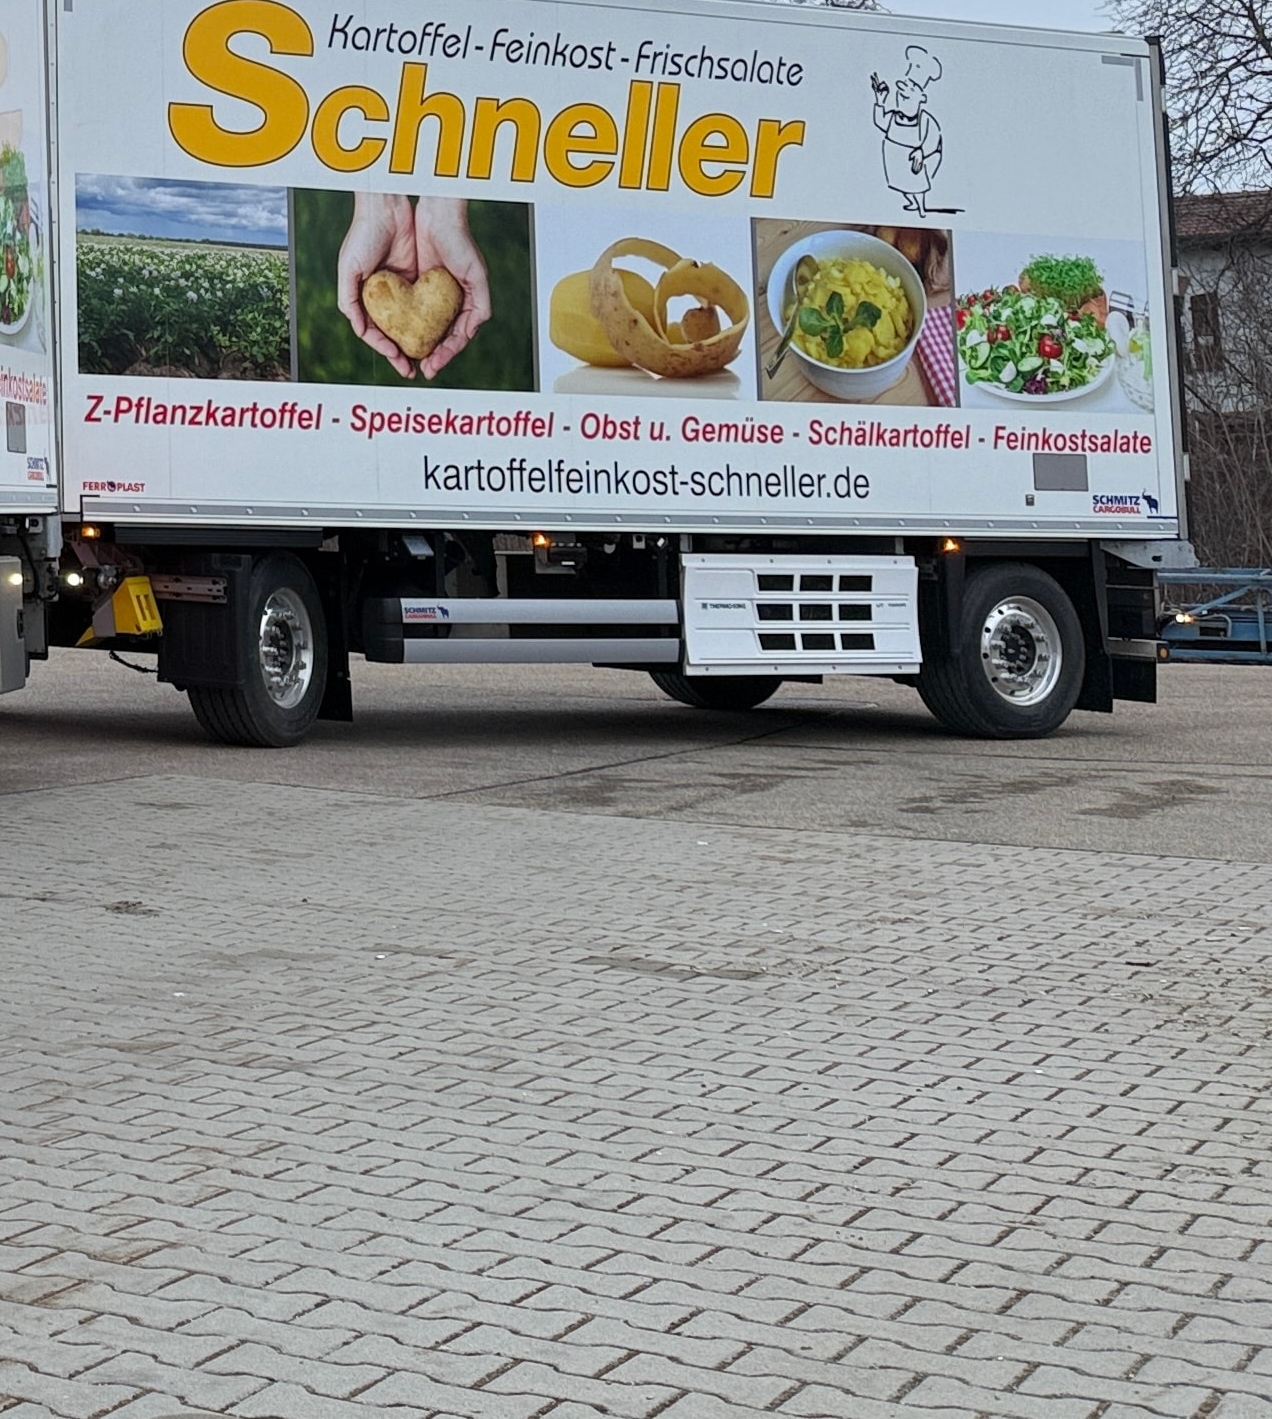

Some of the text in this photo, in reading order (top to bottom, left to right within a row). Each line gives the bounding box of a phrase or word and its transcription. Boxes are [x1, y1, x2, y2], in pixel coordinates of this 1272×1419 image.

[83, 394, 323, 431] Z-Pflanzkartoffel
[349, 404, 555, 439] Speisekartoffel
[580, 412, 642, 441] Obst
[650, 424, 672, 443] u.
[681, 415, 785, 446] Gemüse
[808, 418, 972, 451] Schälkartoffel
[993, 425, 1153, 455] Feinkostsalate
[423, 454, 871, 500] kartoffelfeinkost-schneller.de
[1092, 494, 1141, 506] SCHMITZ
